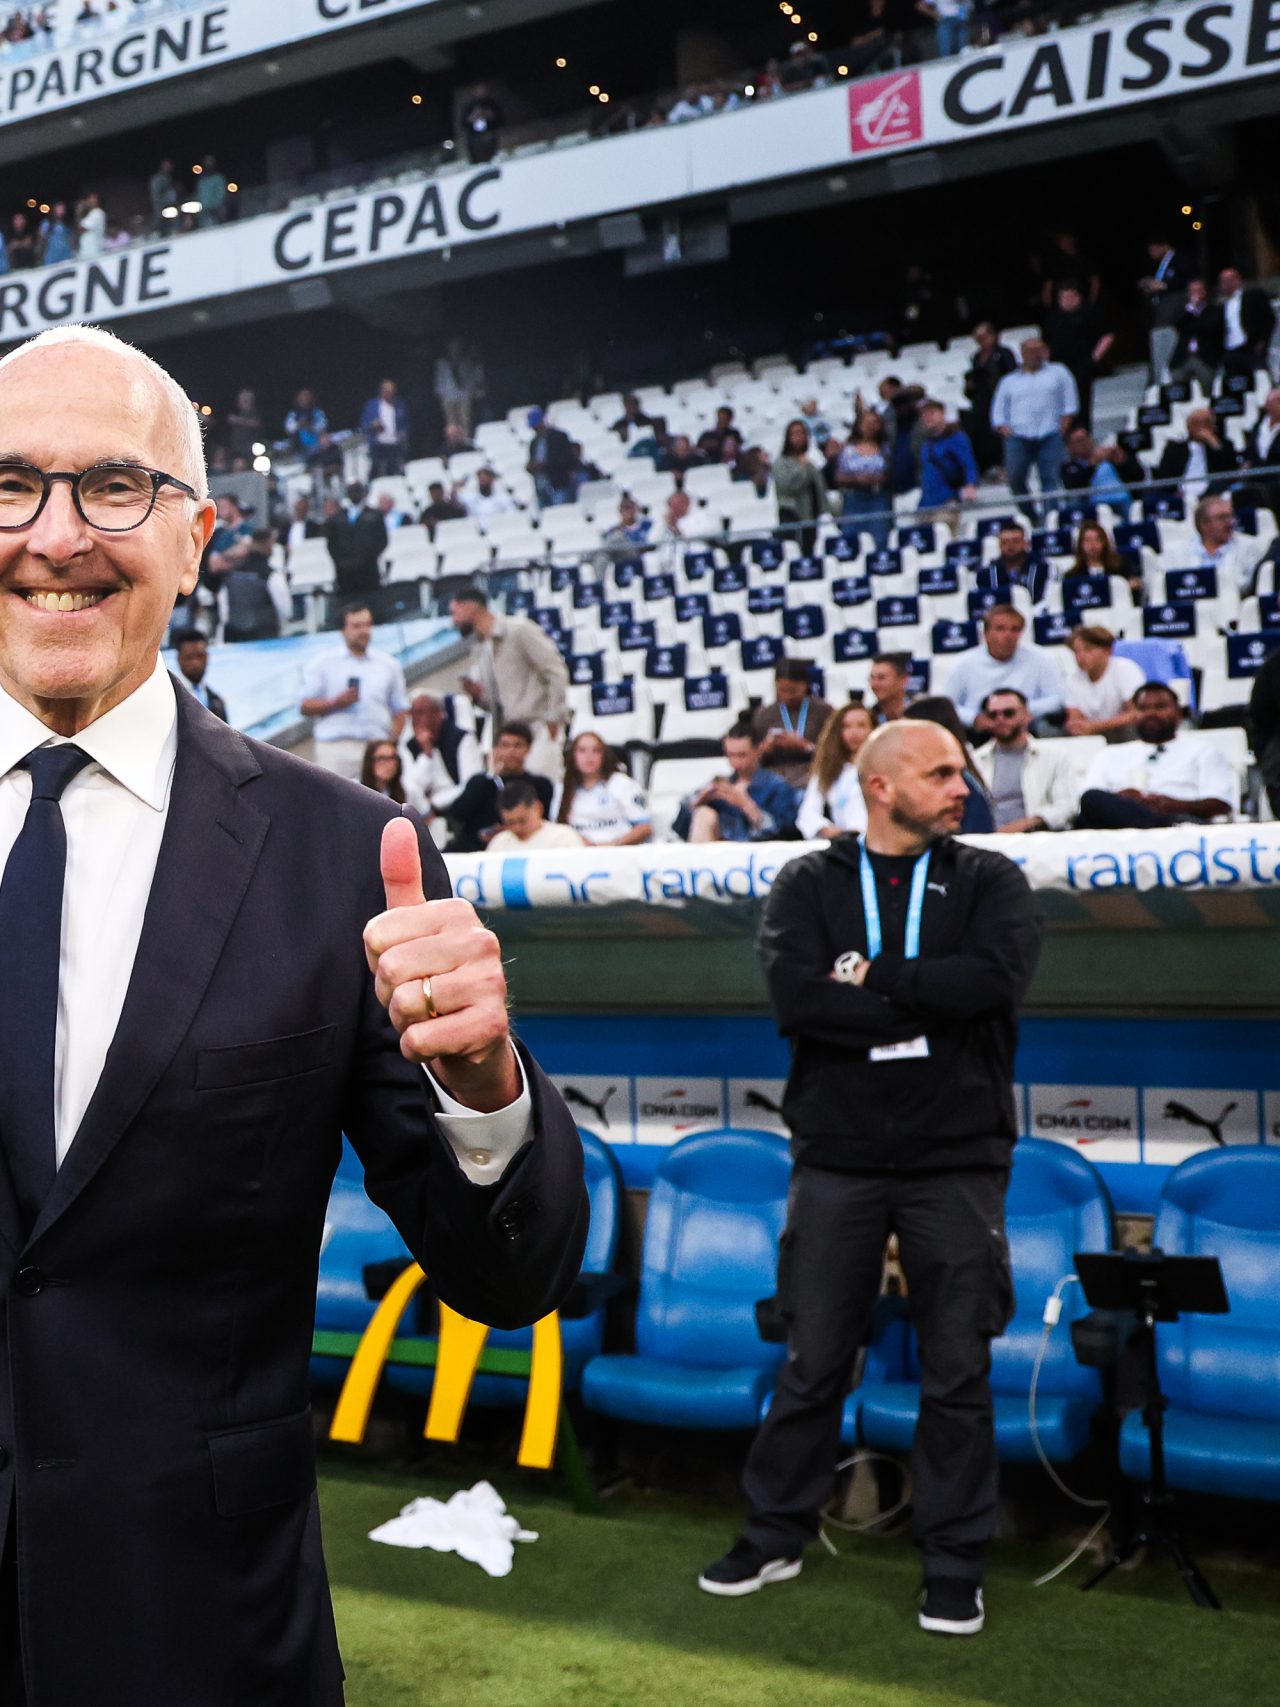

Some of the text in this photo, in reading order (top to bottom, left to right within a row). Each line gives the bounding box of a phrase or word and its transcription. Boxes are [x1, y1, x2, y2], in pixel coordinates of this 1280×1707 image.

[943, 0, 1280, 126] CAISSE
[273, 166, 502, 271] CEPAC
[642, 853, 776, 900] rands
[1066, 836, 1280, 889] randst
[1036, 1114, 1081, 1130] CMA
